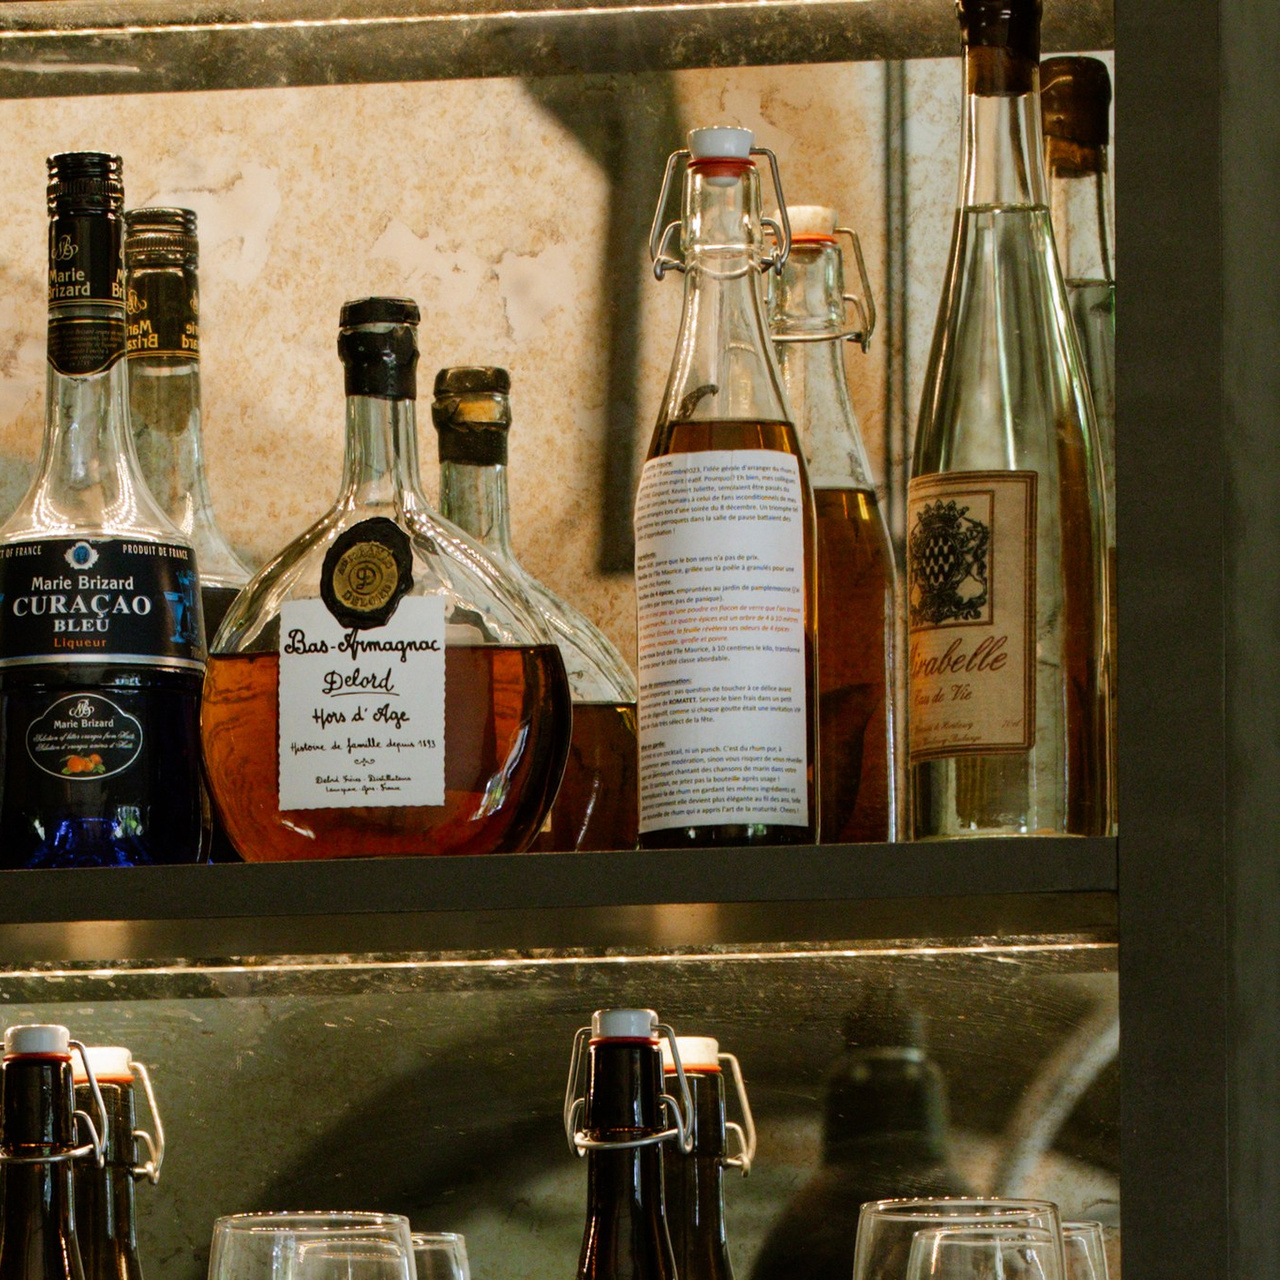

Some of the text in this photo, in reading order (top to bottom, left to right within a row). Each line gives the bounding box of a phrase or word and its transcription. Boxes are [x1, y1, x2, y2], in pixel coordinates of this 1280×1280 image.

[15, 545, 42, 557] FRANCE
[31, 575, 135, 591] Marie Brizard
[12, 594, 152, 619] CURAÇAO
[53, 618, 110, 633] BLEU
[53, 638, 107, 650] Liqueur
[284, 628, 441, 663] Bas-Armagnac
[321, 667, 395, 694] Delord
[951, 683, 973, 701] Vie
[53, 719, 114, 729] Marie Brizard
[312, 708, 347, 730] Hors
[346, 737, 382, 754] famille
